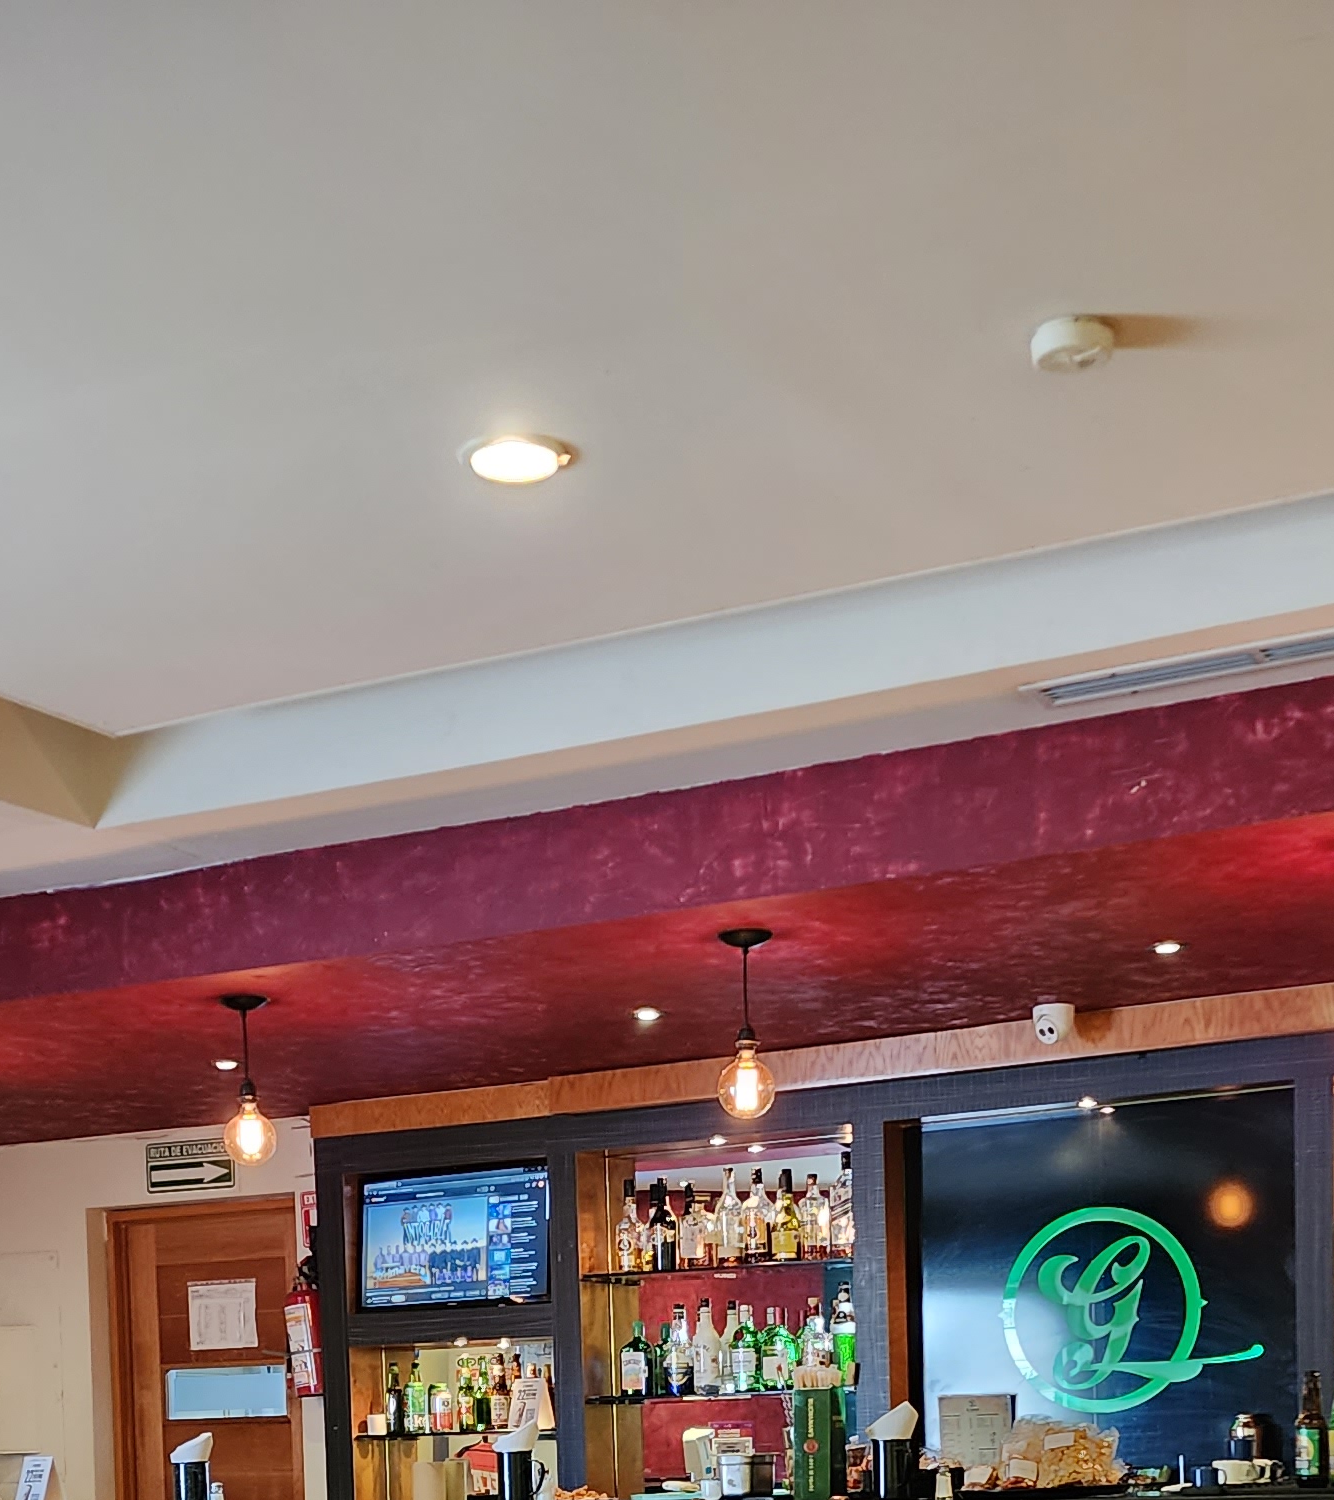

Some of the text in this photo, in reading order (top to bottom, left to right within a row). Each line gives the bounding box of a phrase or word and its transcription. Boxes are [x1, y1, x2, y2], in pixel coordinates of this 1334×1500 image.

[150, 1141, 228, 1158] RUTA DE EVACUACIO
